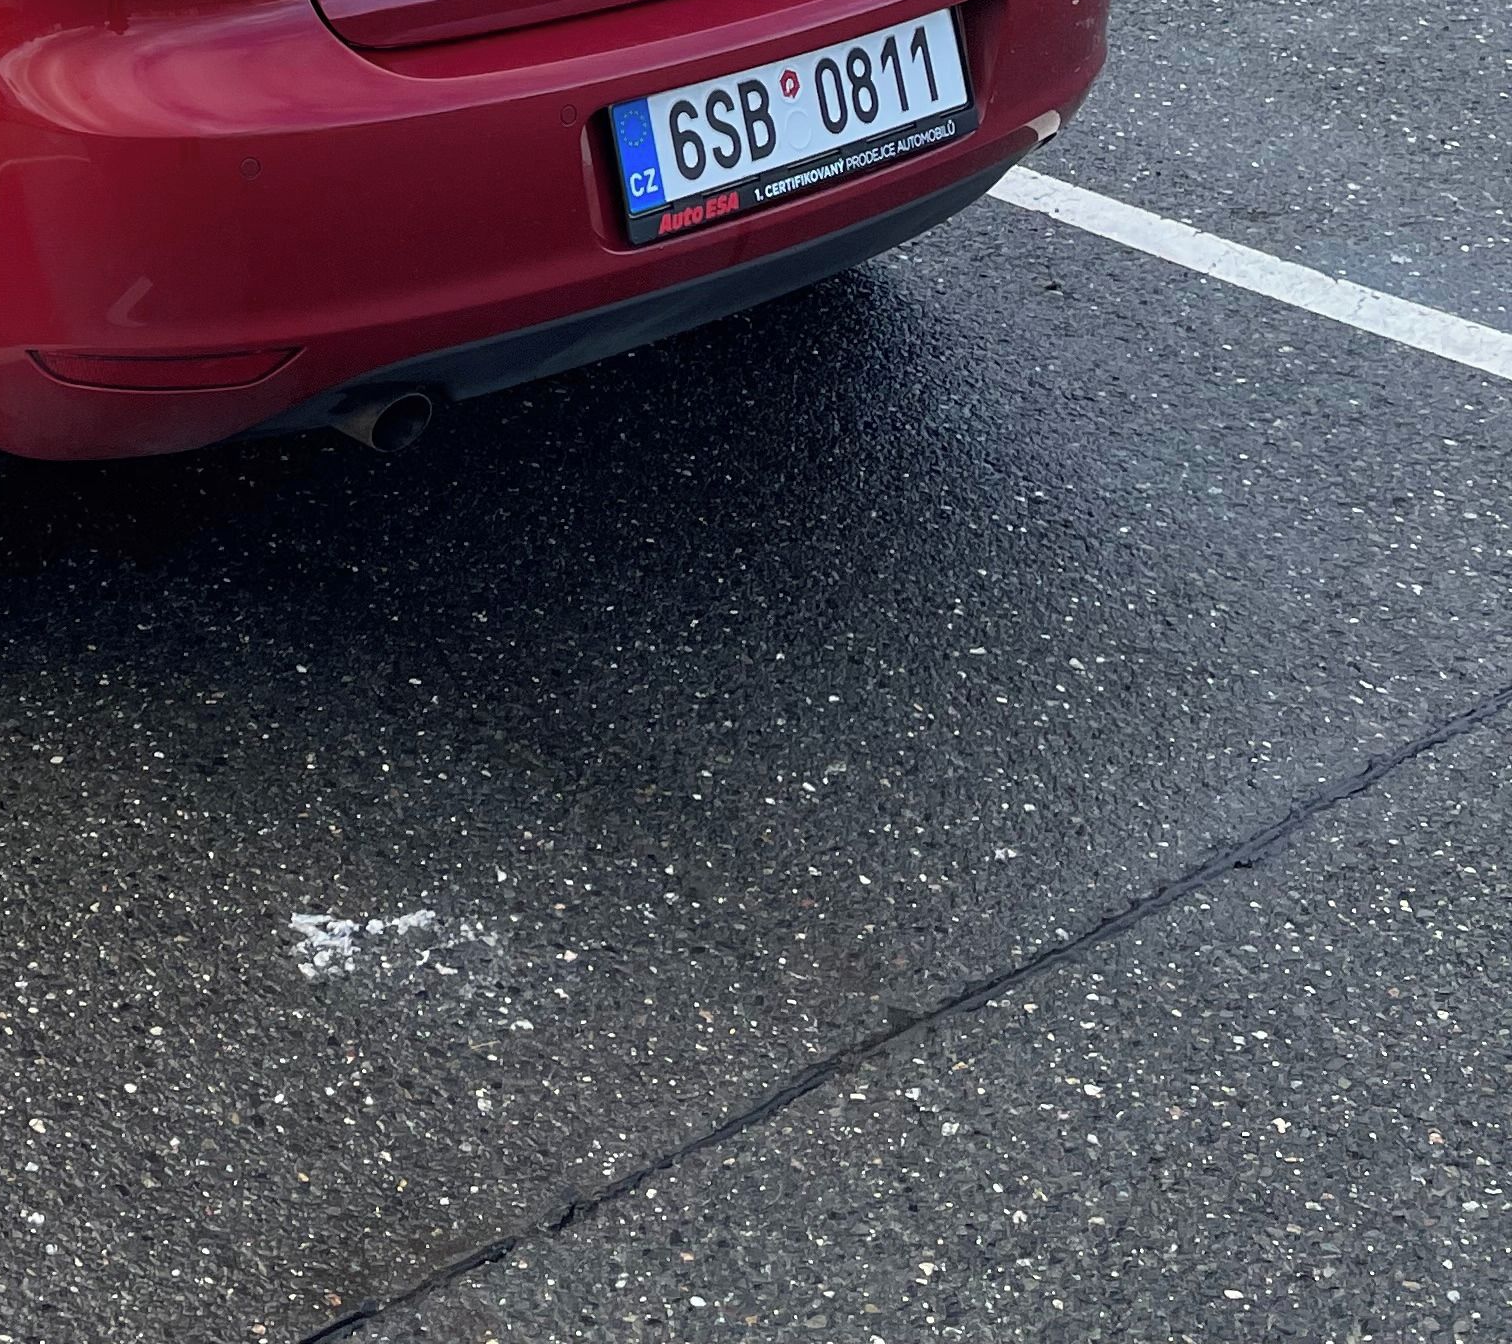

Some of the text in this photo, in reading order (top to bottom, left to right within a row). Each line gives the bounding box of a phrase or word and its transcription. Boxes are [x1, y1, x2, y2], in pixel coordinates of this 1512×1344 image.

[669, 25, 938, 180] 6SB 0811
[629, 168, 659, 197] CZ
[755, 120, 956, 202] 1. CERTIFIKOVANÝ PRODEJCE AUTOMOBILŮ
[658, 192, 740, 234] Auto ESA
